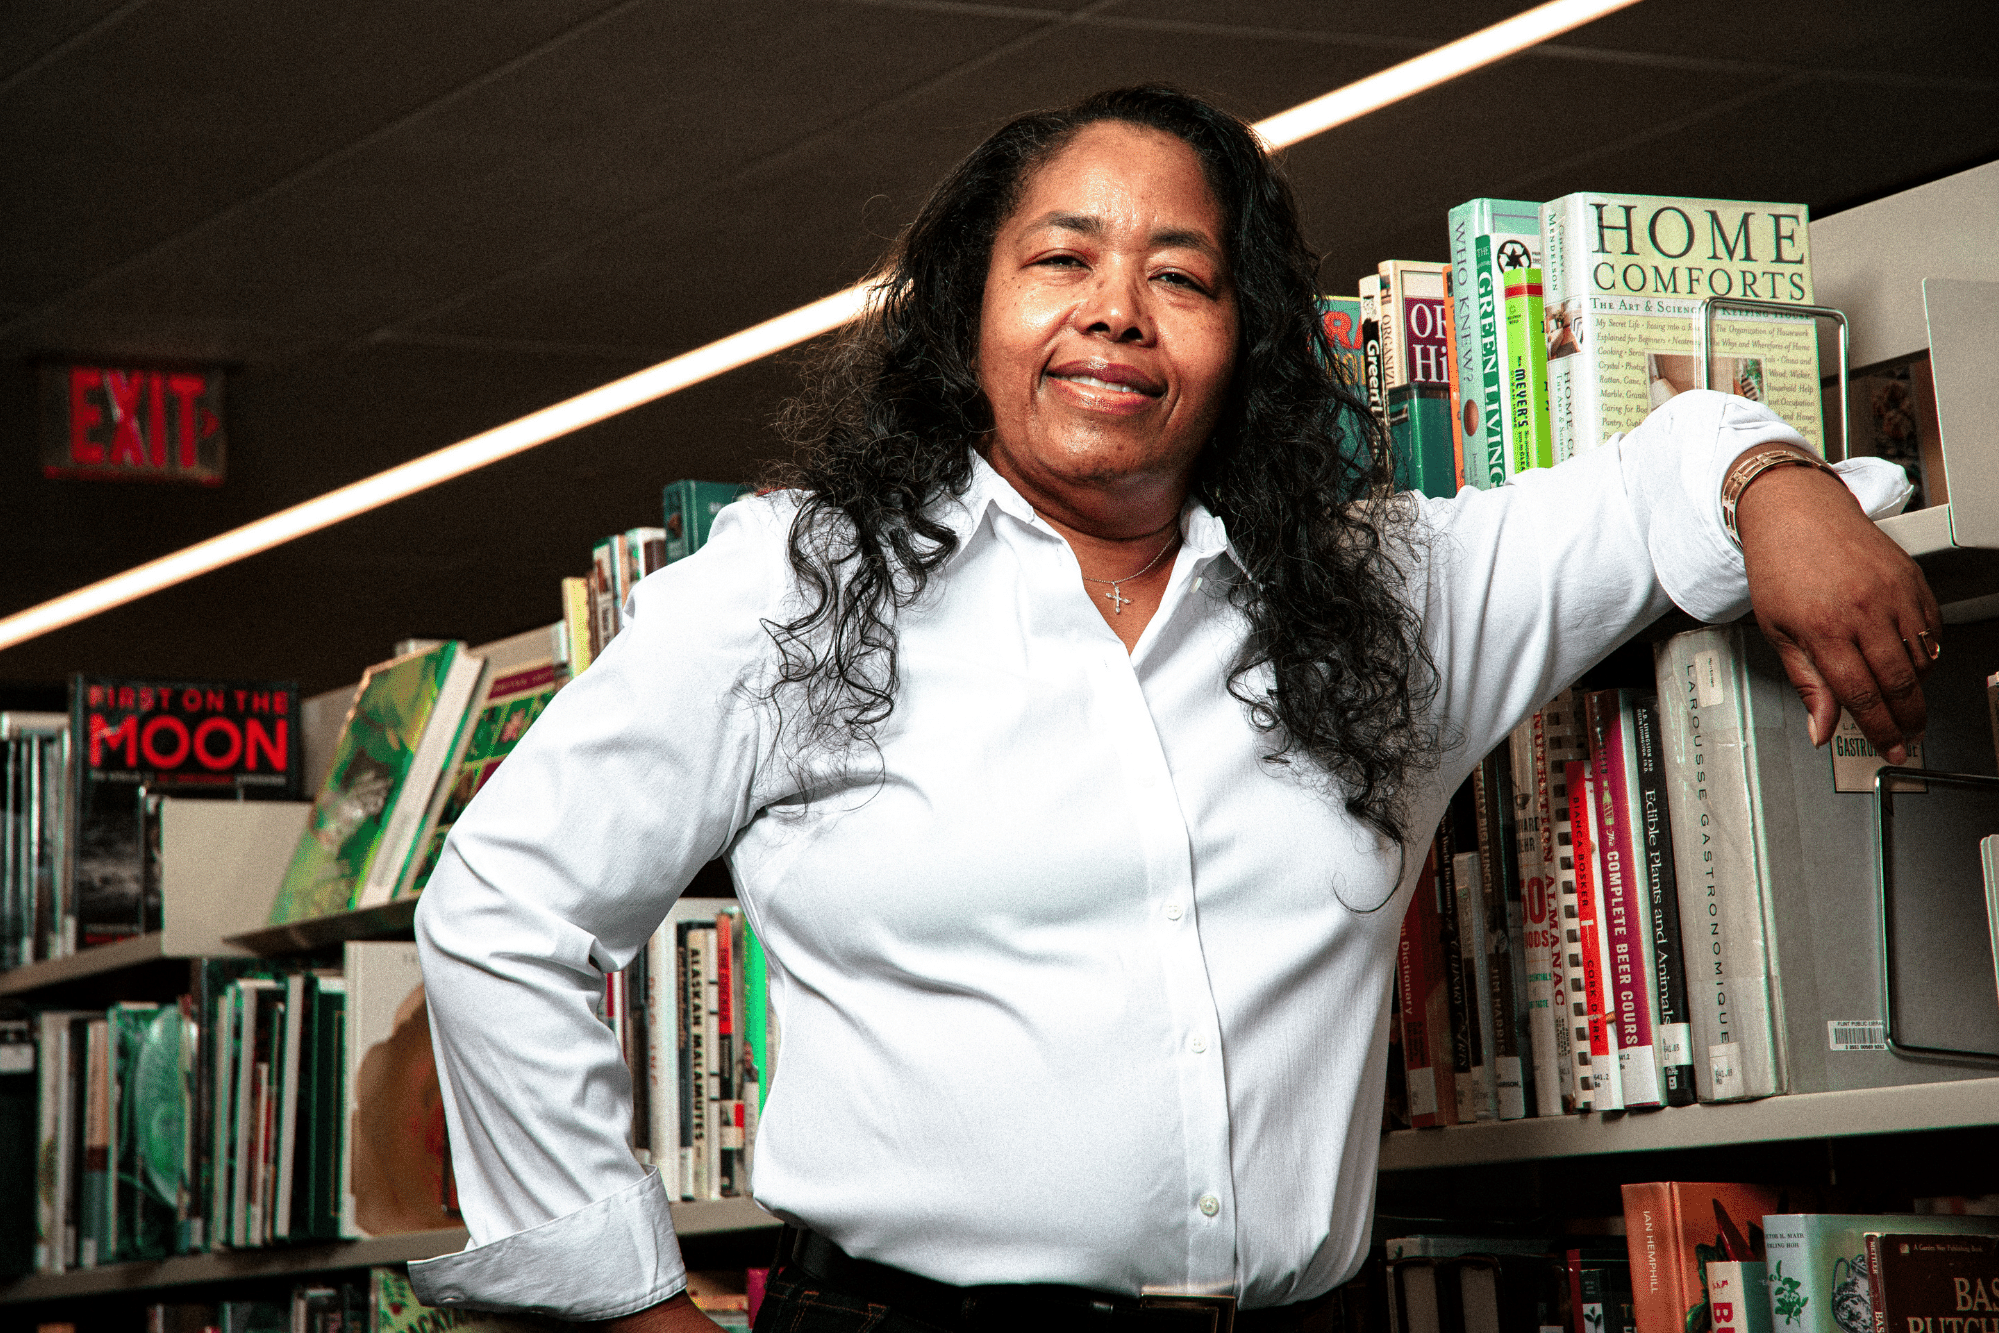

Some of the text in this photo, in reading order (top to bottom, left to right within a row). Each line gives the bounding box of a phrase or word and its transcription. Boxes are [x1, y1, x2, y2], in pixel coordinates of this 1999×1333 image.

[1454, 222, 1467, 287] WHO
[1548, 213, 1559, 291] MENDELSON
[1590, 203, 1804, 264] HOME
[1590, 298, 1614, 310] THE
[1619, 300, 1639, 311] ART
[1645, 301, 1652, 312] &
[1657, 301, 1701, 314] SCIENC
[1593, 262, 1806, 301] COMFORTS
[1381, 314, 1396, 389] ORGANIZI
[1458, 296, 1474, 384] KNEW?
[1596, 318, 1605, 328] My
[1608, 319, 1626, 328] Secret
[1628, 320, 1640, 331] Life
[1597, 333, 1626, 343] Explained
[1627, 335, 1637, 344] for
[1638, 335, 1666, 345] Beginners
[1598, 347, 1623, 358] Cooking
[1728, 325, 1766, 336] Organization
[1768, 328, 1775, 338] of
[1776, 329, 1808, 337] Housework
[1738, 340, 1750, 348] and
[1477, 271, 1505, 488] GREEN LIVING
[1599, 361, 1620, 371] Crystal
[1800, 357, 1812, 365] and
[69, 367, 206, 468] EXIT
[1515, 368, 1529, 428] MEYER'S
[1563, 370, 1574, 431] HOME
[1601, 403, 1623, 415] Caring
[1624, 404, 1634, 415] for
[88, 685, 289, 716] FIRST ON THE
[88, 712, 289, 773] MOON
[1836, 735, 1919, 758] GASTROUE
[1478, 817, 1489, 843] BIG
[1572, 796, 1589, 908] BIANCA BOSKER
[1686, 663, 1731, 1045] LAROUSSE GASTRONOMIQUE
[1481, 845, 1492, 893] LUNCH
[1644, 788, 1676, 1024] Edible Plants and Animals
[1545, 873, 1566, 1007] ALMANAC
[1605, 830, 1639, 1046] The COMPLETE BEER COURS
[1401, 939, 1414, 1016] Dictionary
[1490, 965, 1501, 994] JIM
[1587, 959, 1600, 1043] CORK DORK
[690, 948, 705, 1141] ALASKAN MALAMUTES
[1643, 1210, 1659, 1294] IAN HEMPHILL
[1869, 1240, 1878, 1275] METTLER
